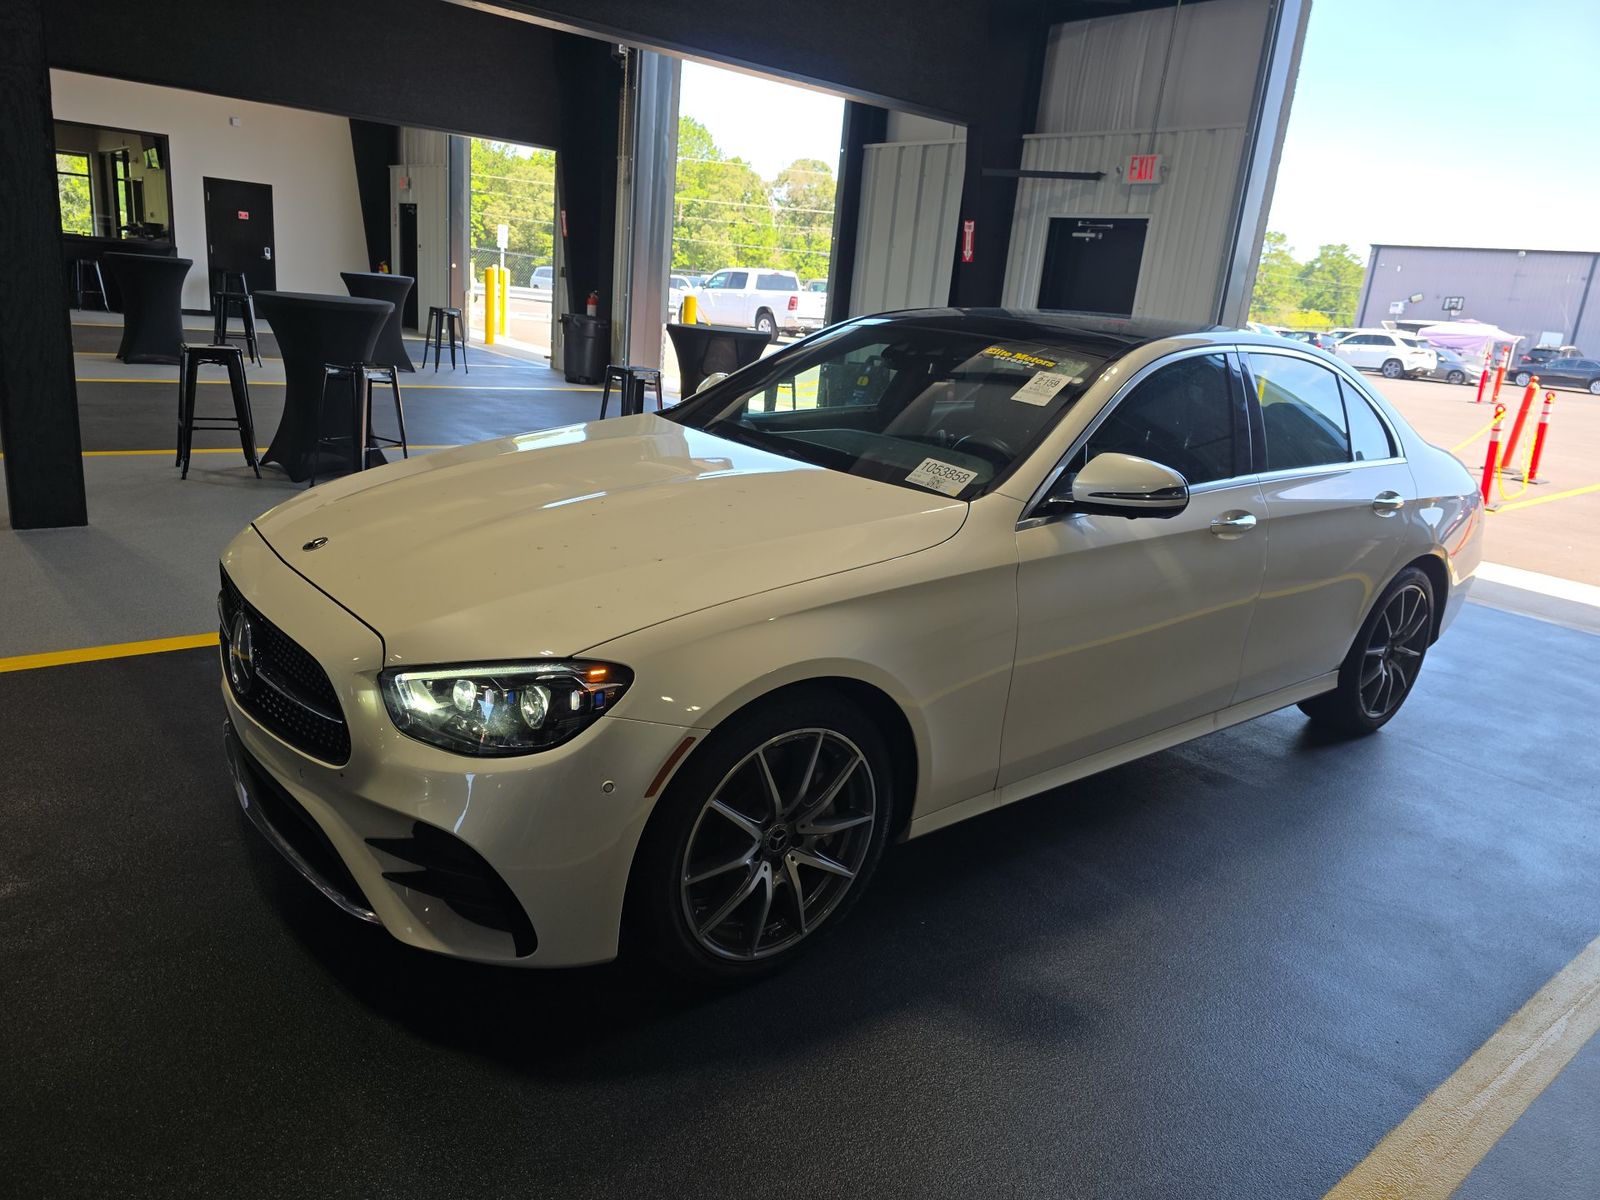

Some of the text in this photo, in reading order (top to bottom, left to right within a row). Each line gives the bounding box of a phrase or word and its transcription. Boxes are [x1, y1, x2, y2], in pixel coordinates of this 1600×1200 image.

[1129, 156, 1157, 180] EXIT
[1013, 353, 1056, 368] Motors
[920, 461, 971, 484] 1053858
